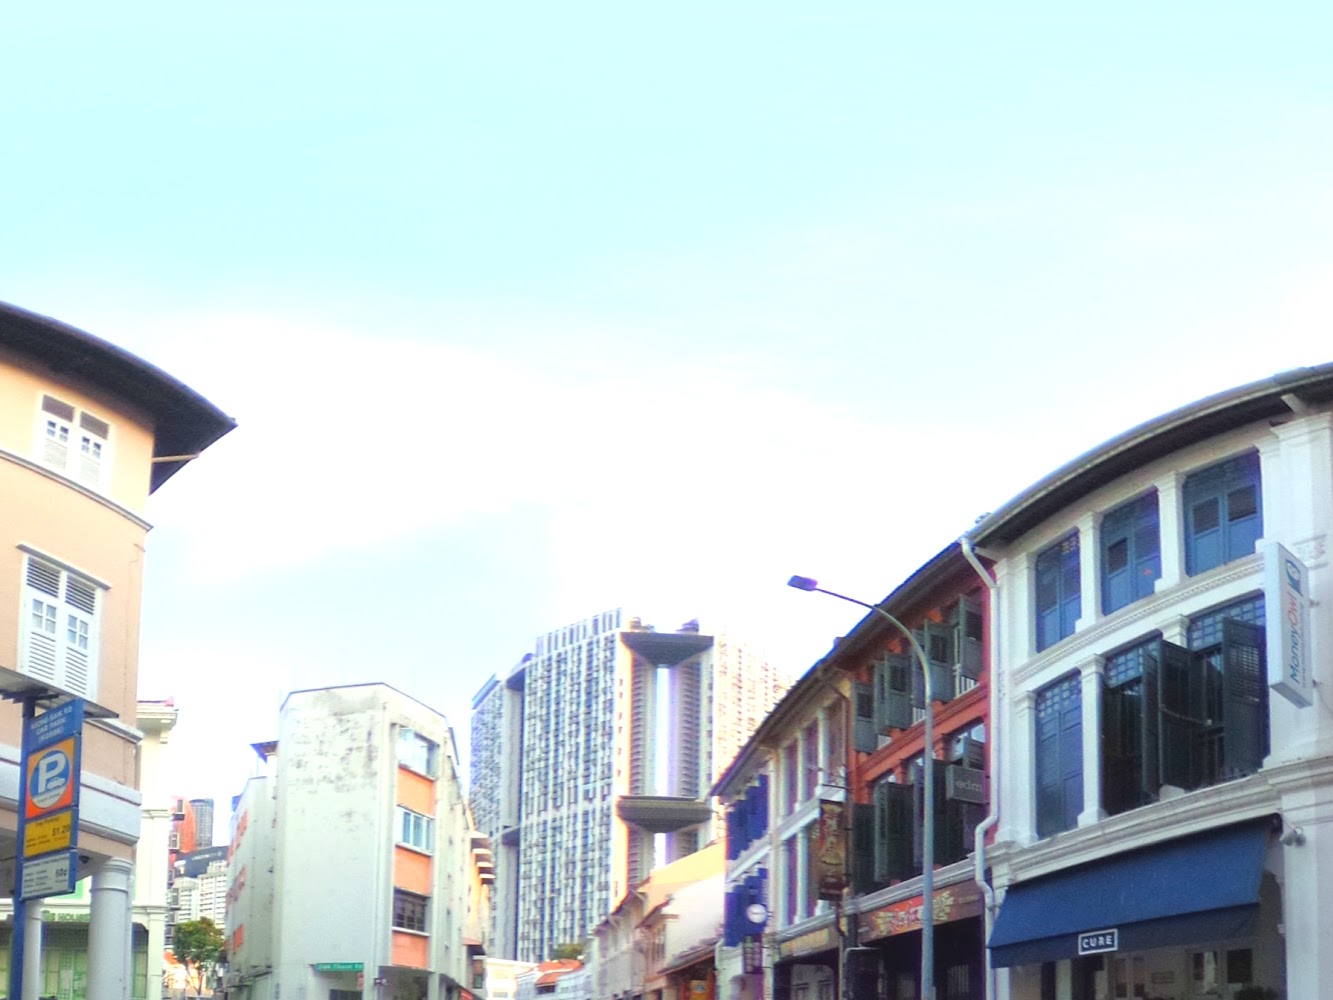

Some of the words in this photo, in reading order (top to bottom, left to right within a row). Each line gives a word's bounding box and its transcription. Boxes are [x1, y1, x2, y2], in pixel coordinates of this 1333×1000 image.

[1287, 592, 1301, 684] MoneyOwl
[38, 752, 66, 794] P
[1082, 935, 1114, 949] CURE
